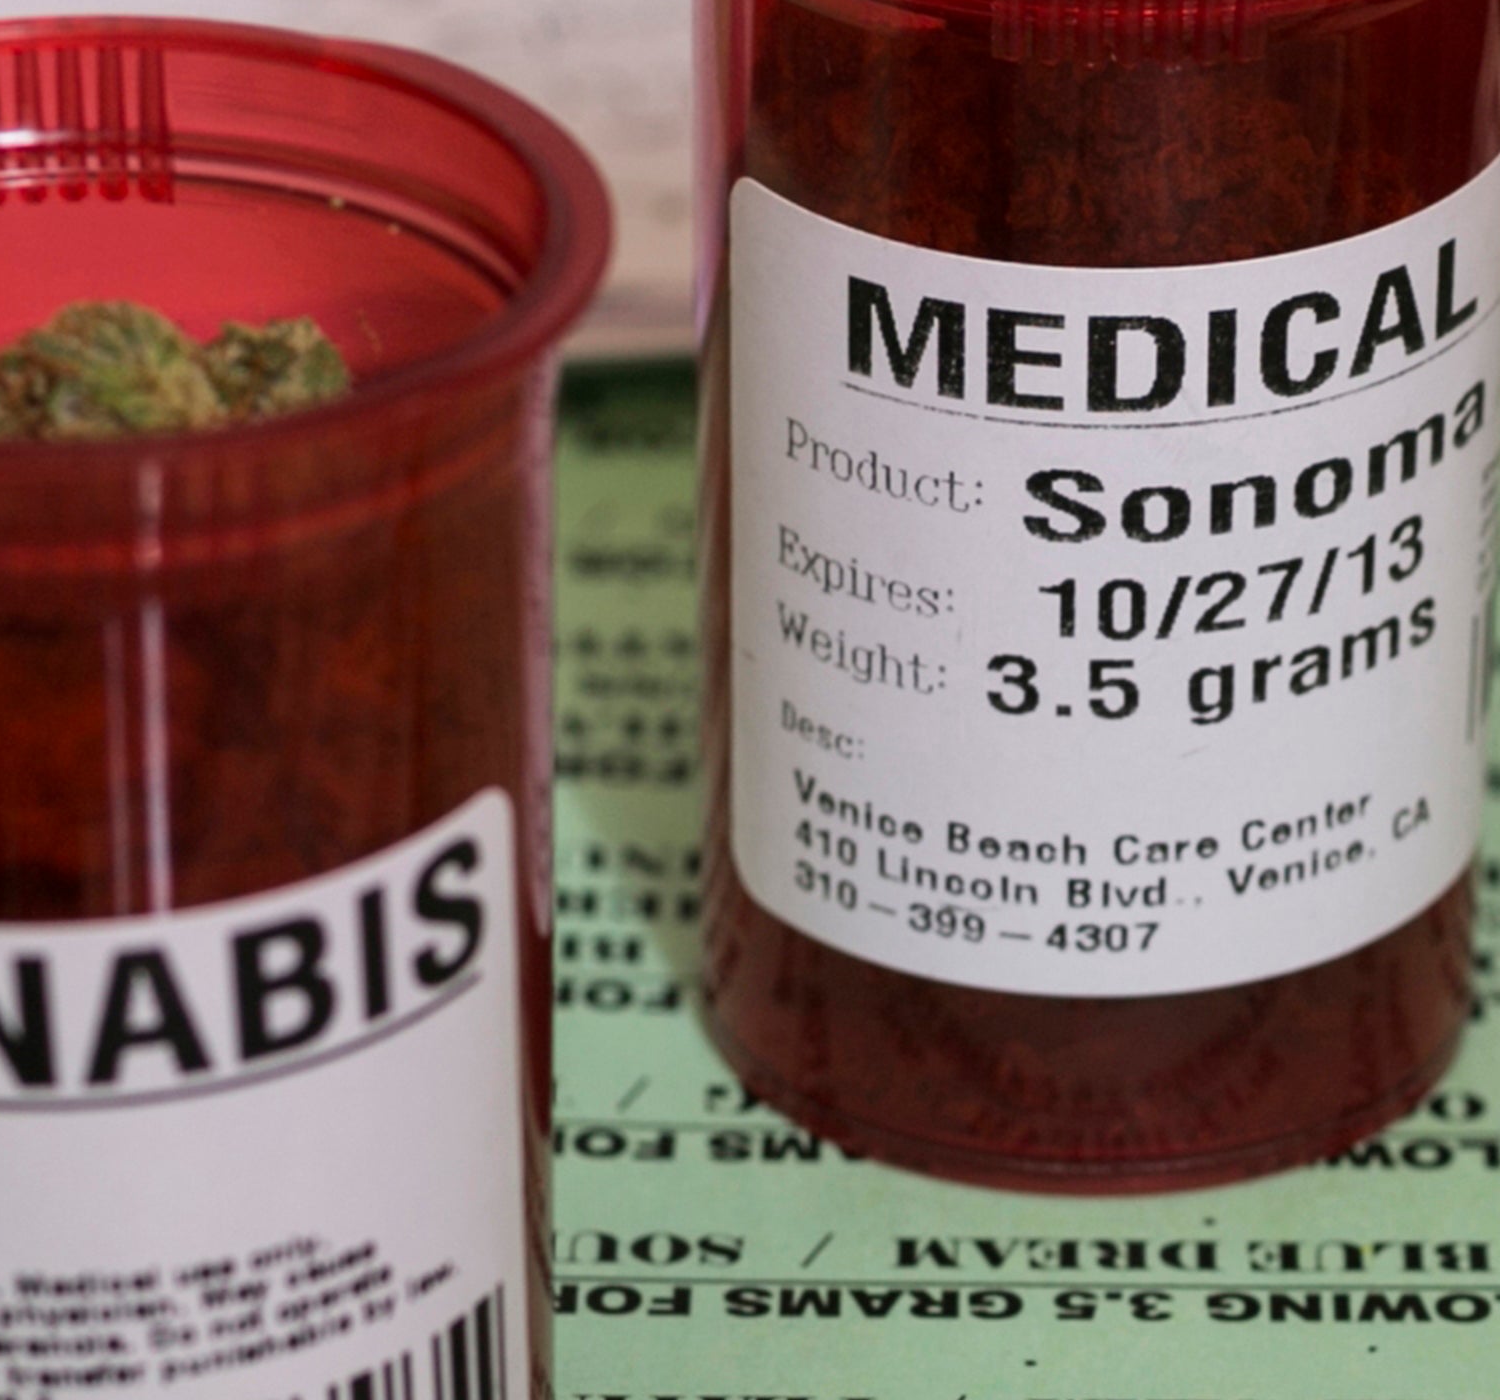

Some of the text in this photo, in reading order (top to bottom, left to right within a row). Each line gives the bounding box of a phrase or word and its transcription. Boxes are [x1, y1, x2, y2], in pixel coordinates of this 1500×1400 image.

[845, 238, 1480, 413] MEDICAL
[783, 375, 1489, 544] Product: Sonoma
[777, 515, 1426, 643] Expires: 10/27/13
[777, 601, 949, 695] Weight:
[985, 652, 1142, 720] 3.5
[1186, 595, 1440, 726] grams
[780, 699, 867, 761] Desc:
[790, 767, 1376, 868] Venice Beach Care Center
[792, 820, 860, 869] 410
[875, 848, 1041, 908] Lincoln
[1389, 795, 1434, 845] CA
[723, 1286, 1026, 1320] GRAMS
[891, 1234, 1221, 1272] DREAM
[1245, 1236, 1492, 1274] BLUE
[1051, 1288, 1176, 1321] 3.5
